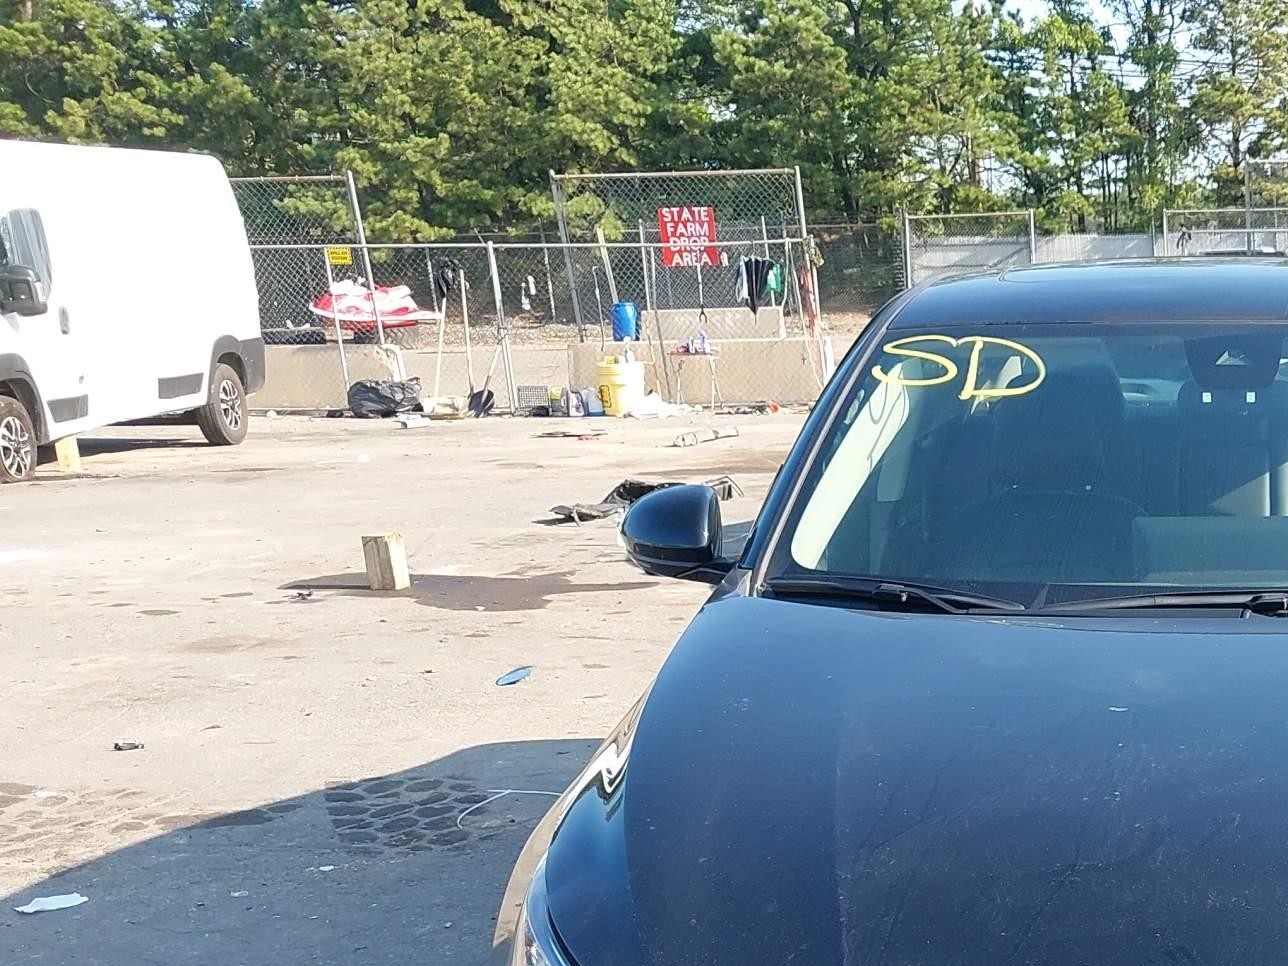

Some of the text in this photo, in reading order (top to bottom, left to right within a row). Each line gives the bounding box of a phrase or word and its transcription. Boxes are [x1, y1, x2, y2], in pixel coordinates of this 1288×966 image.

[661, 207, 709, 222] STATE
[666, 222, 709, 236] FARM
[669, 237, 709, 251] DROP
[672, 252, 712, 266] AREA
[871, 334, 1046, 400] SD
